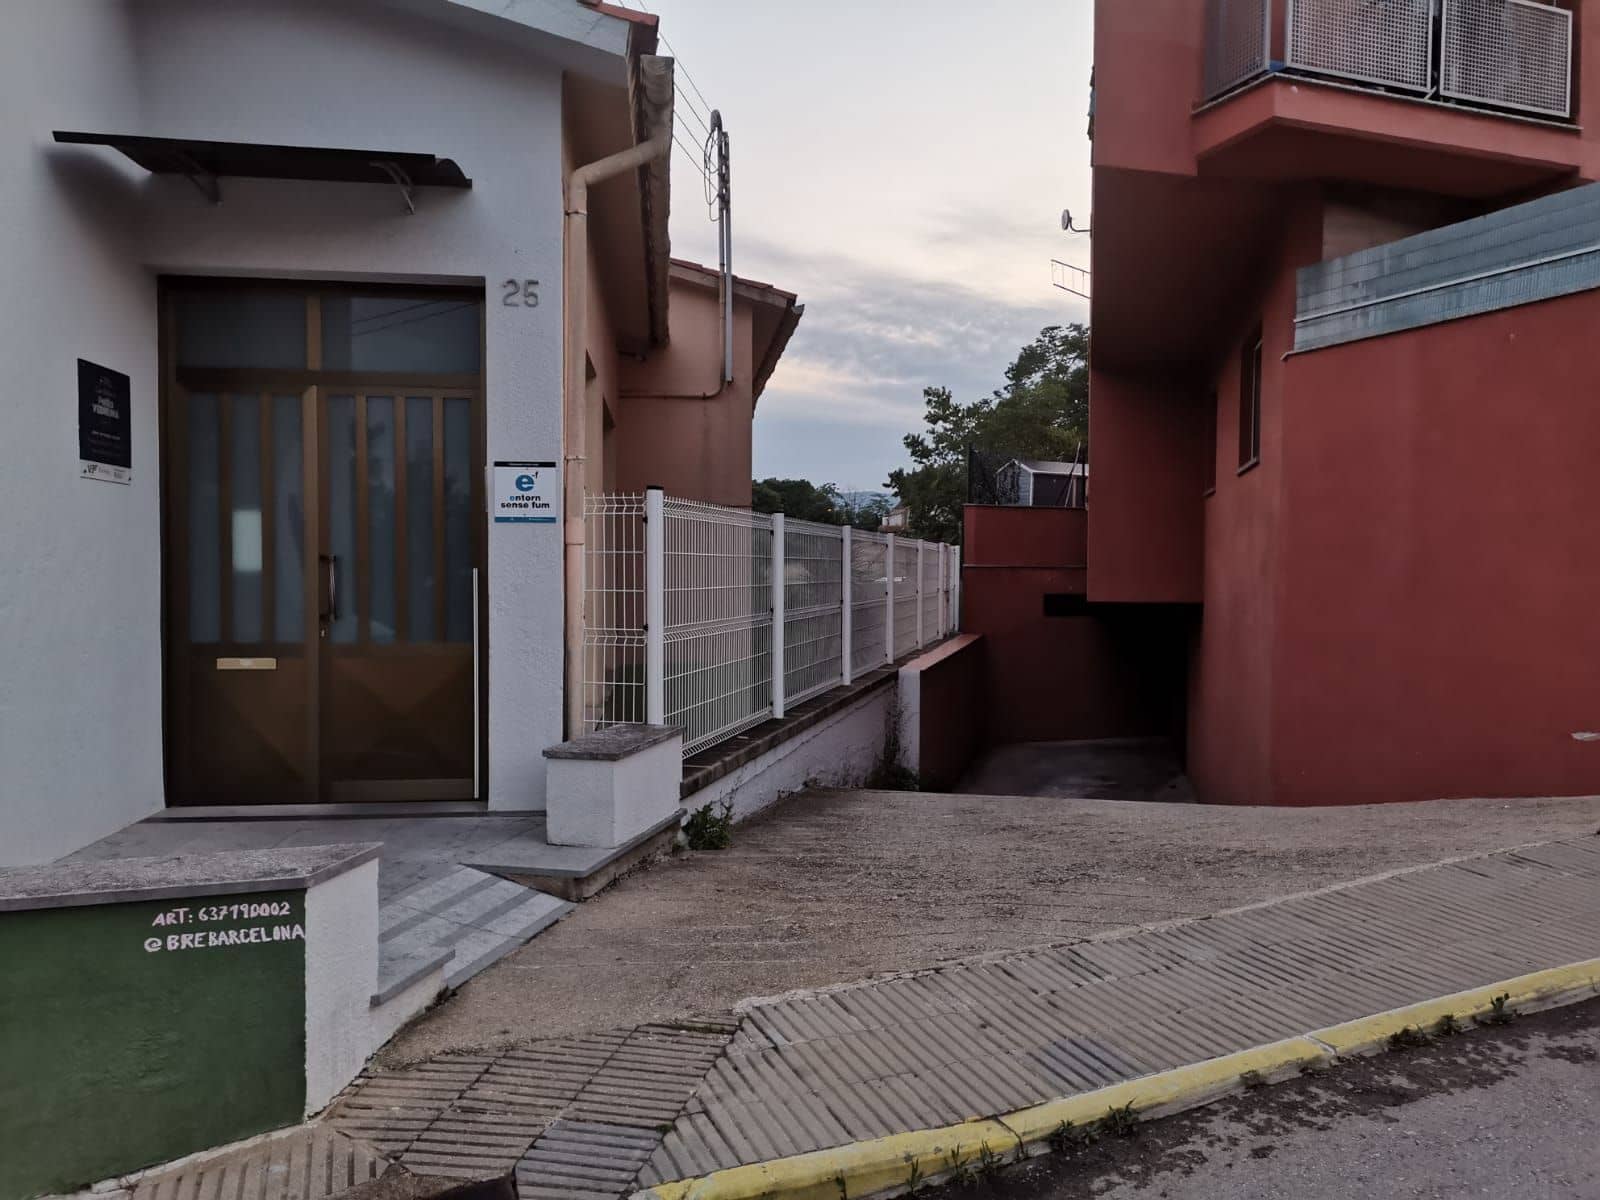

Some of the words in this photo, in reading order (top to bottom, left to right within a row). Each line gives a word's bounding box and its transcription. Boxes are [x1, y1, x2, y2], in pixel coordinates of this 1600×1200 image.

[502, 279, 539, 308] 25
[509, 494, 541, 502] entorn
[531, 501, 550, 509] fum
[152, 907, 193, 926] ART:
